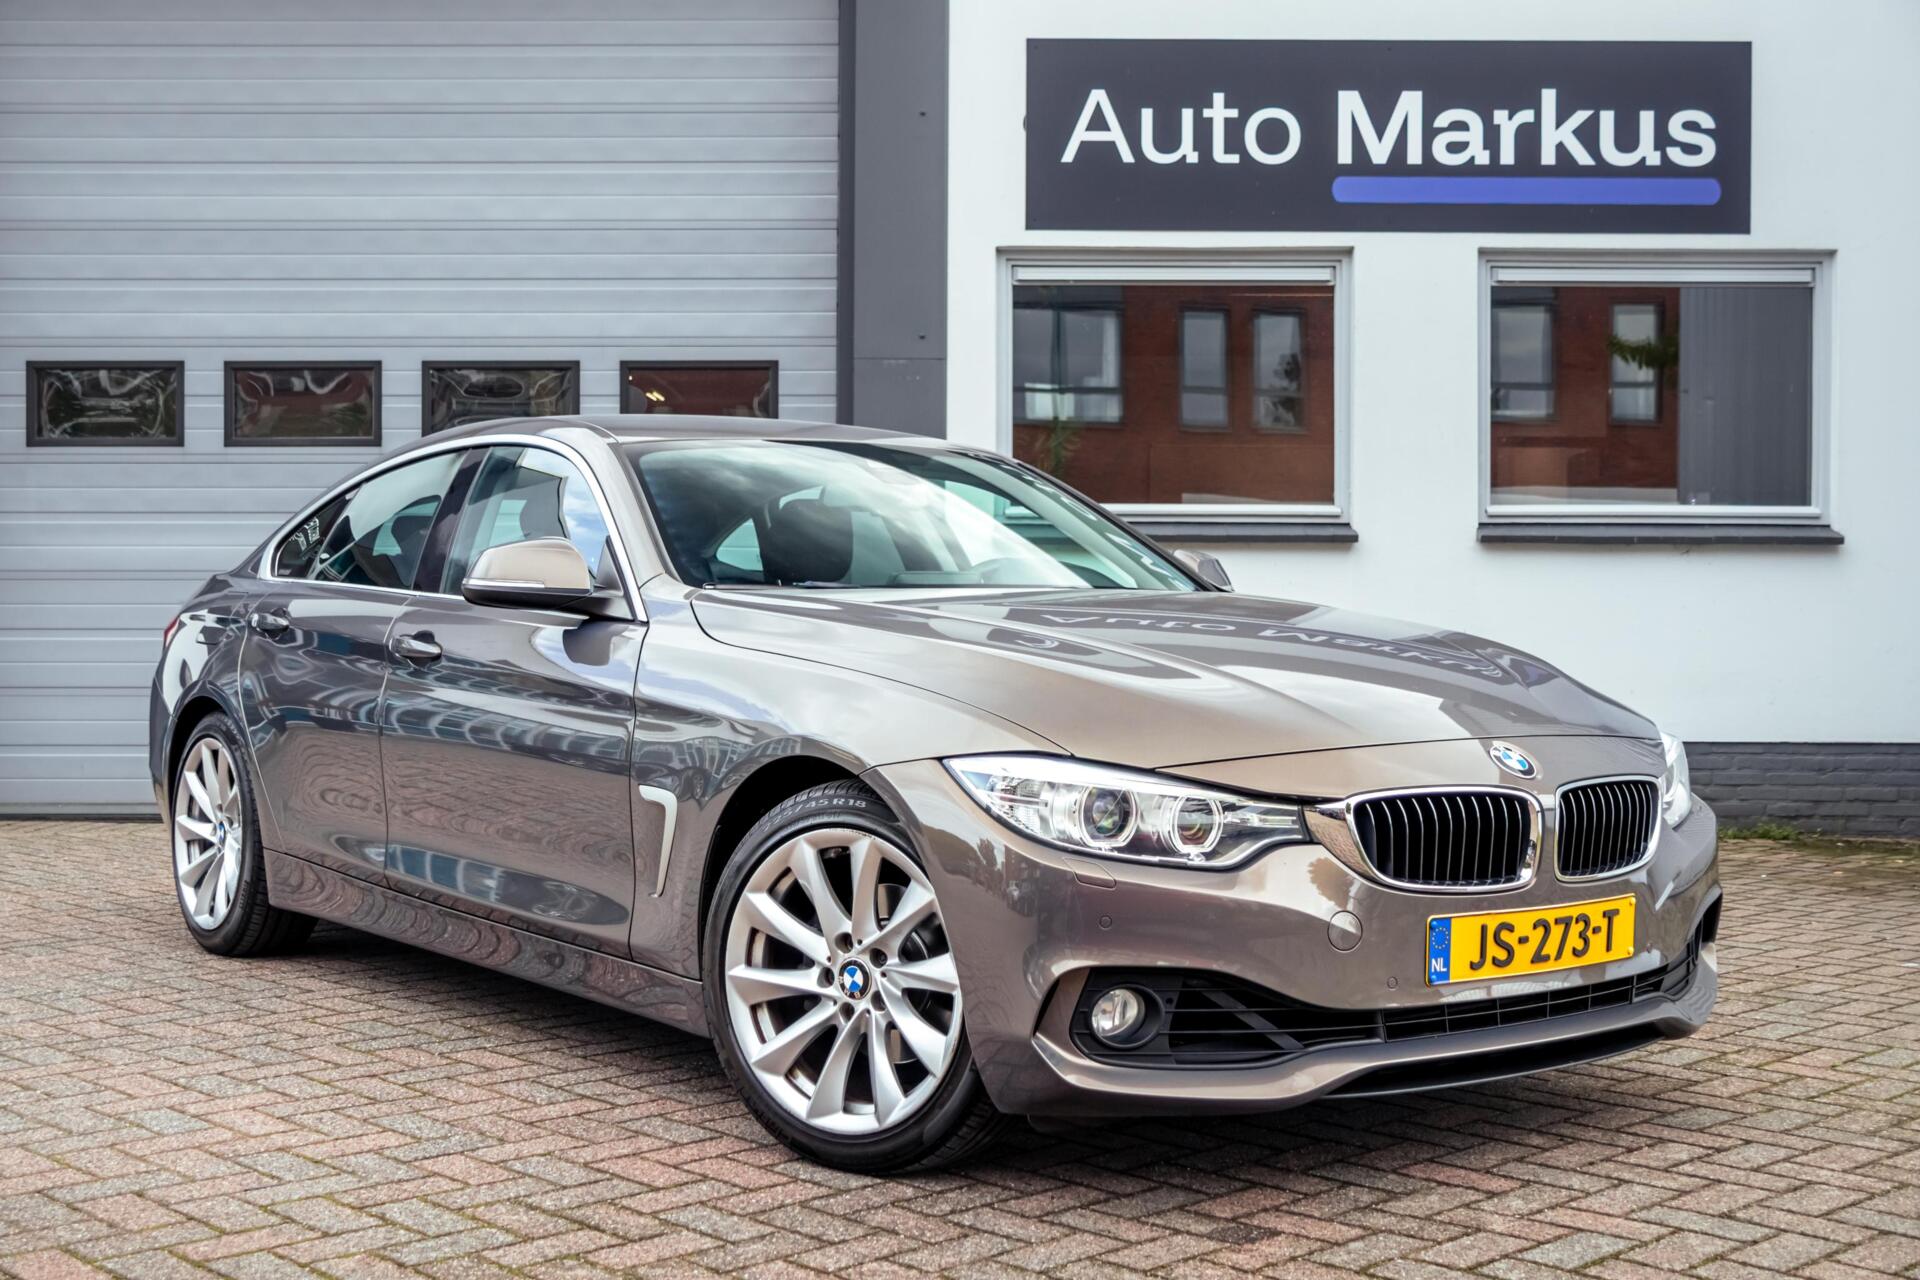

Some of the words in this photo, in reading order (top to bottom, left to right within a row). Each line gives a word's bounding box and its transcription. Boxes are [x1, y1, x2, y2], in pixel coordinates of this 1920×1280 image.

[1060, 88, 1302, 165] Auto
[1337, 88, 1716, 167] Markus
[1431, 957, 1447, 972] NL
[1469, 908, 1620, 971] JS-273-T
